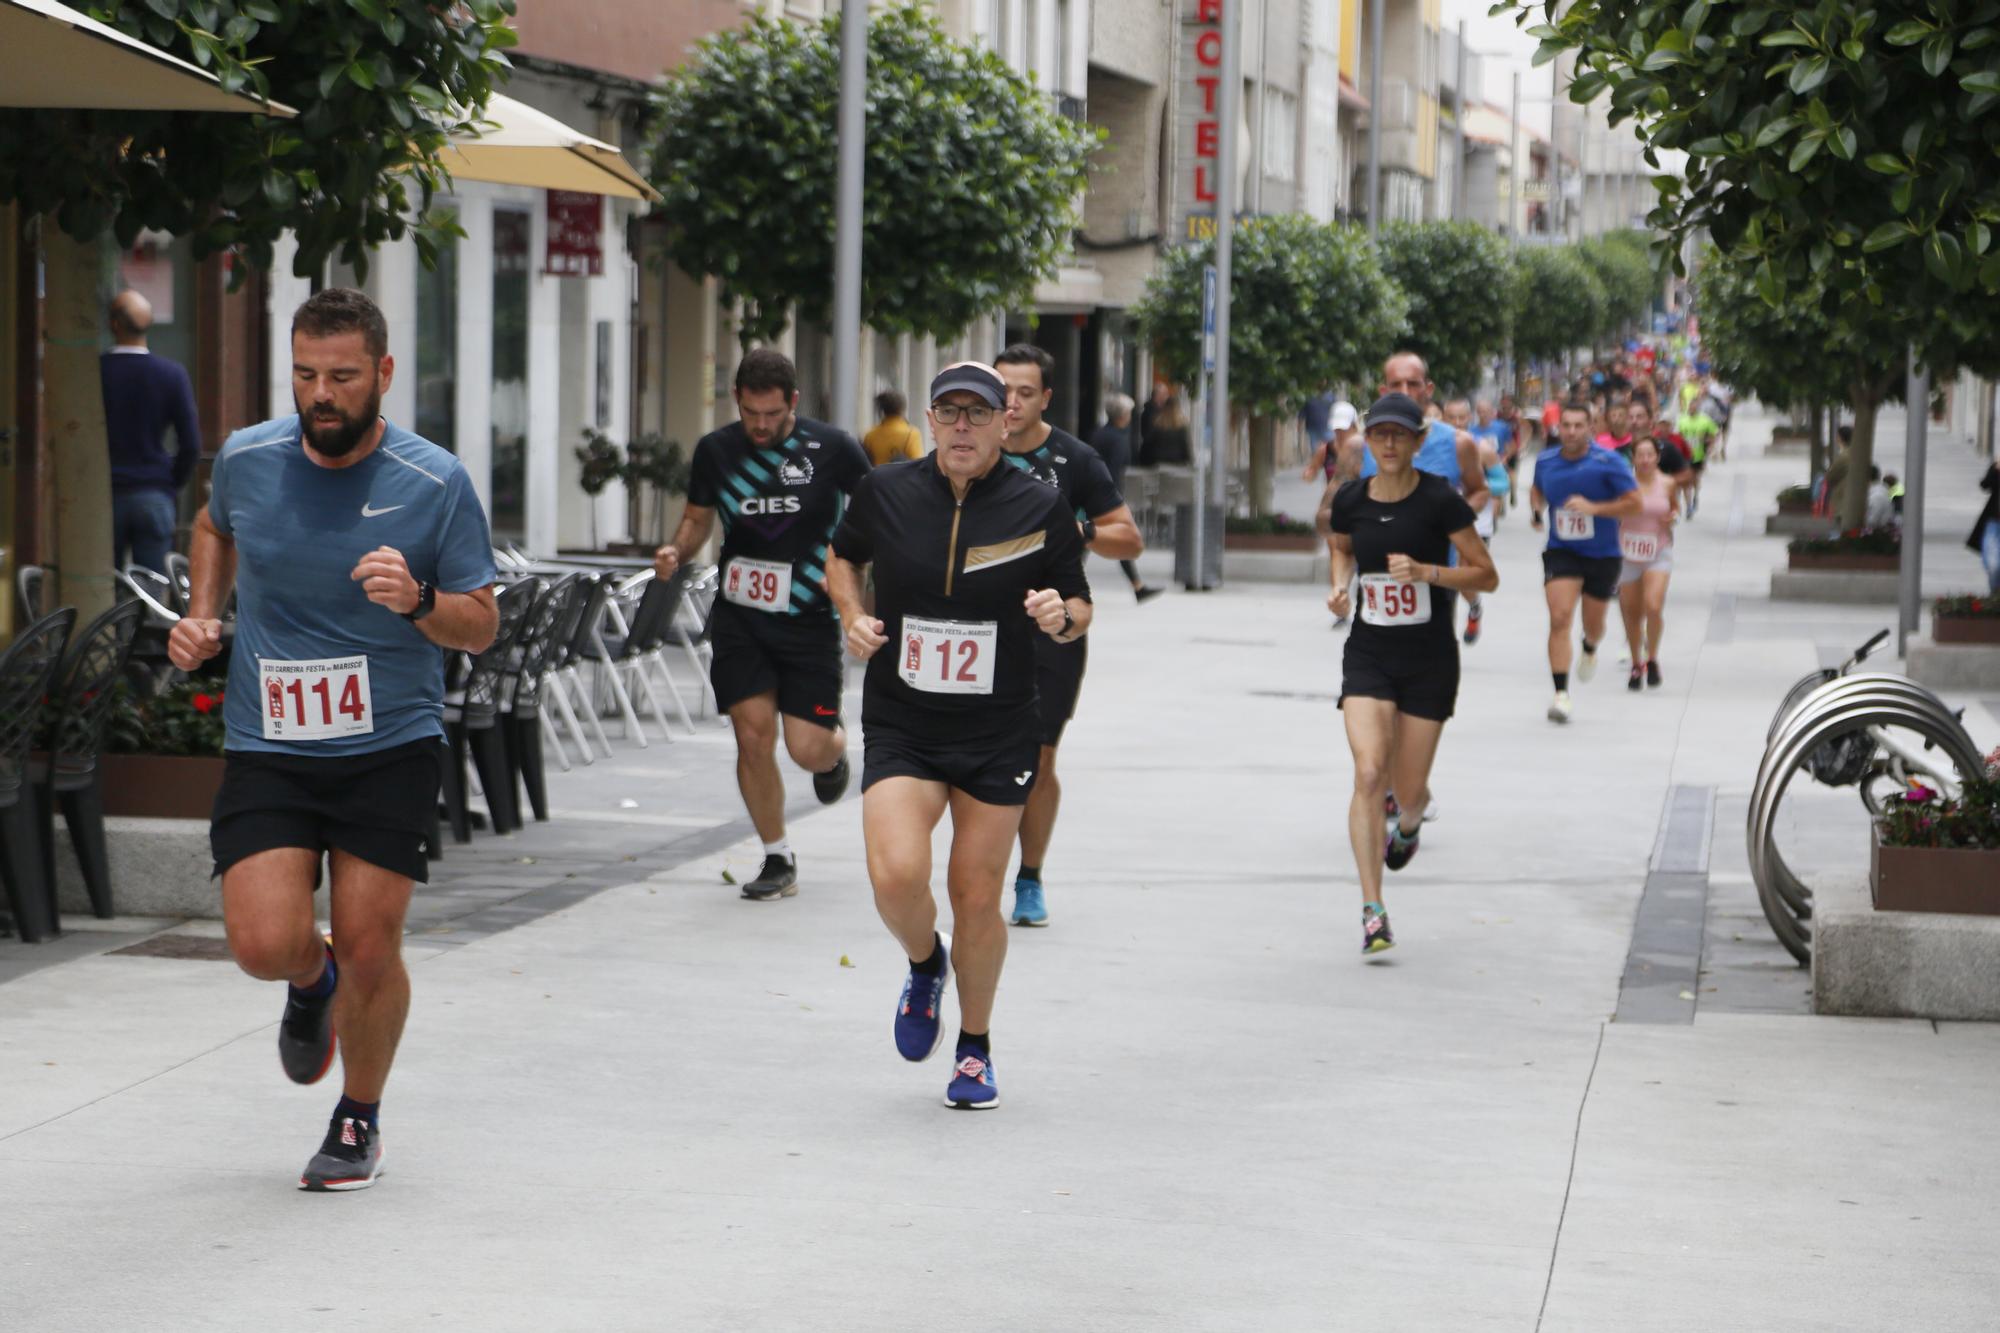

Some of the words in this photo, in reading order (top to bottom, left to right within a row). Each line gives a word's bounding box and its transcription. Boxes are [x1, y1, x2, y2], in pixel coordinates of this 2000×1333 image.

[740, 496, 801, 515] CIES
[1568, 517, 1586, 534] 76
[1631, 541, 1654, 556] 100
[748, 570, 778, 604] 39
[1384, 584, 1417, 617] 59
[275, 665, 304, 673] CARREIRA
[306, 664, 325, 672] FESTA
[333, 660, 363, 670] MARISCO
[936, 639, 979, 682] 12
[286, 673, 365, 727] 114
